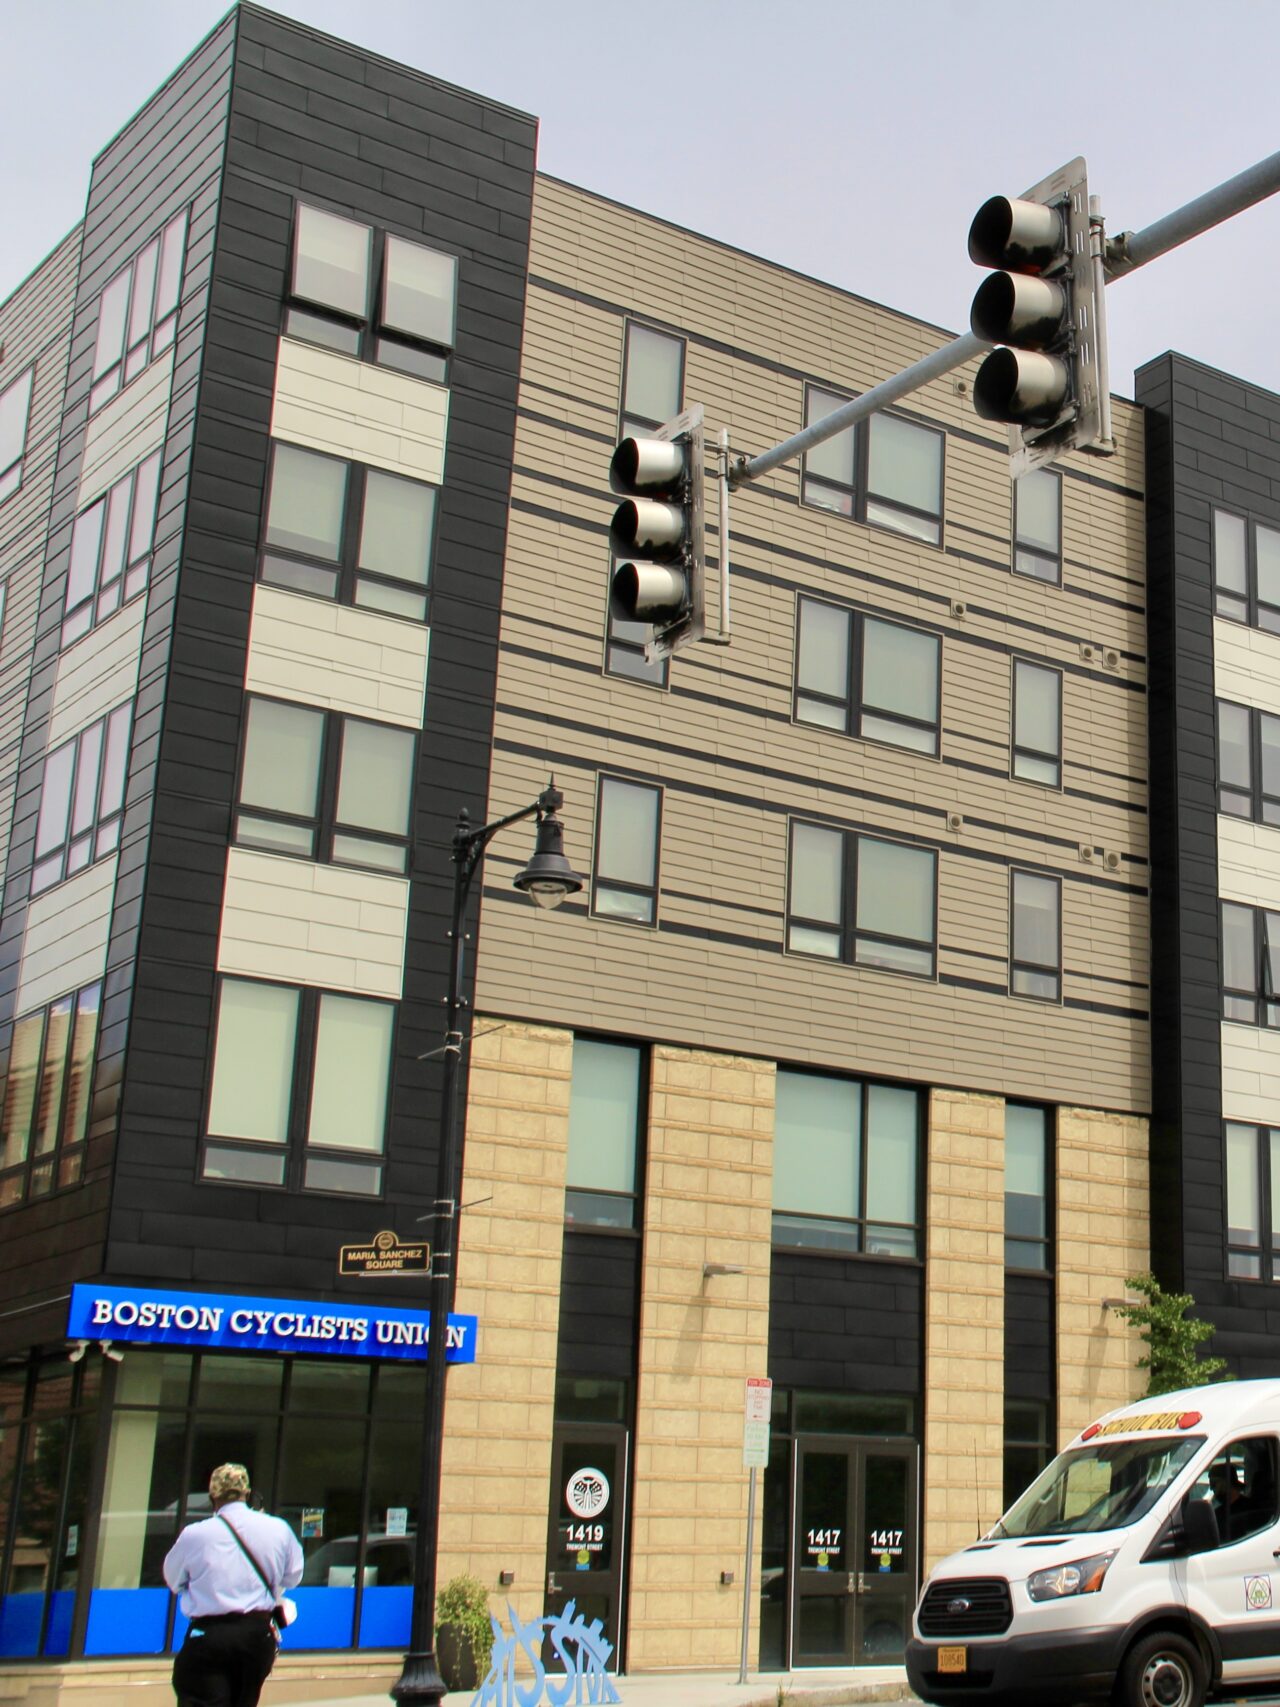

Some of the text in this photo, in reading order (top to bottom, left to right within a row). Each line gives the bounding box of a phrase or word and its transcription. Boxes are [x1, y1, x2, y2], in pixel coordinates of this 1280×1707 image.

[348, 1249, 423, 1261] MARIA SANCHEZ
[366, 1260, 403, 1270] SQUARE
[92, 1299, 467, 1349] BOSTON CYCLISTS UNIN
[1150, 1412, 1184, 1429] BUS
[566, 1524, 604, 1541] 1419
[808, 1529, 840, 1546] 1417
[871, 1530, 902, 1547] 1417
